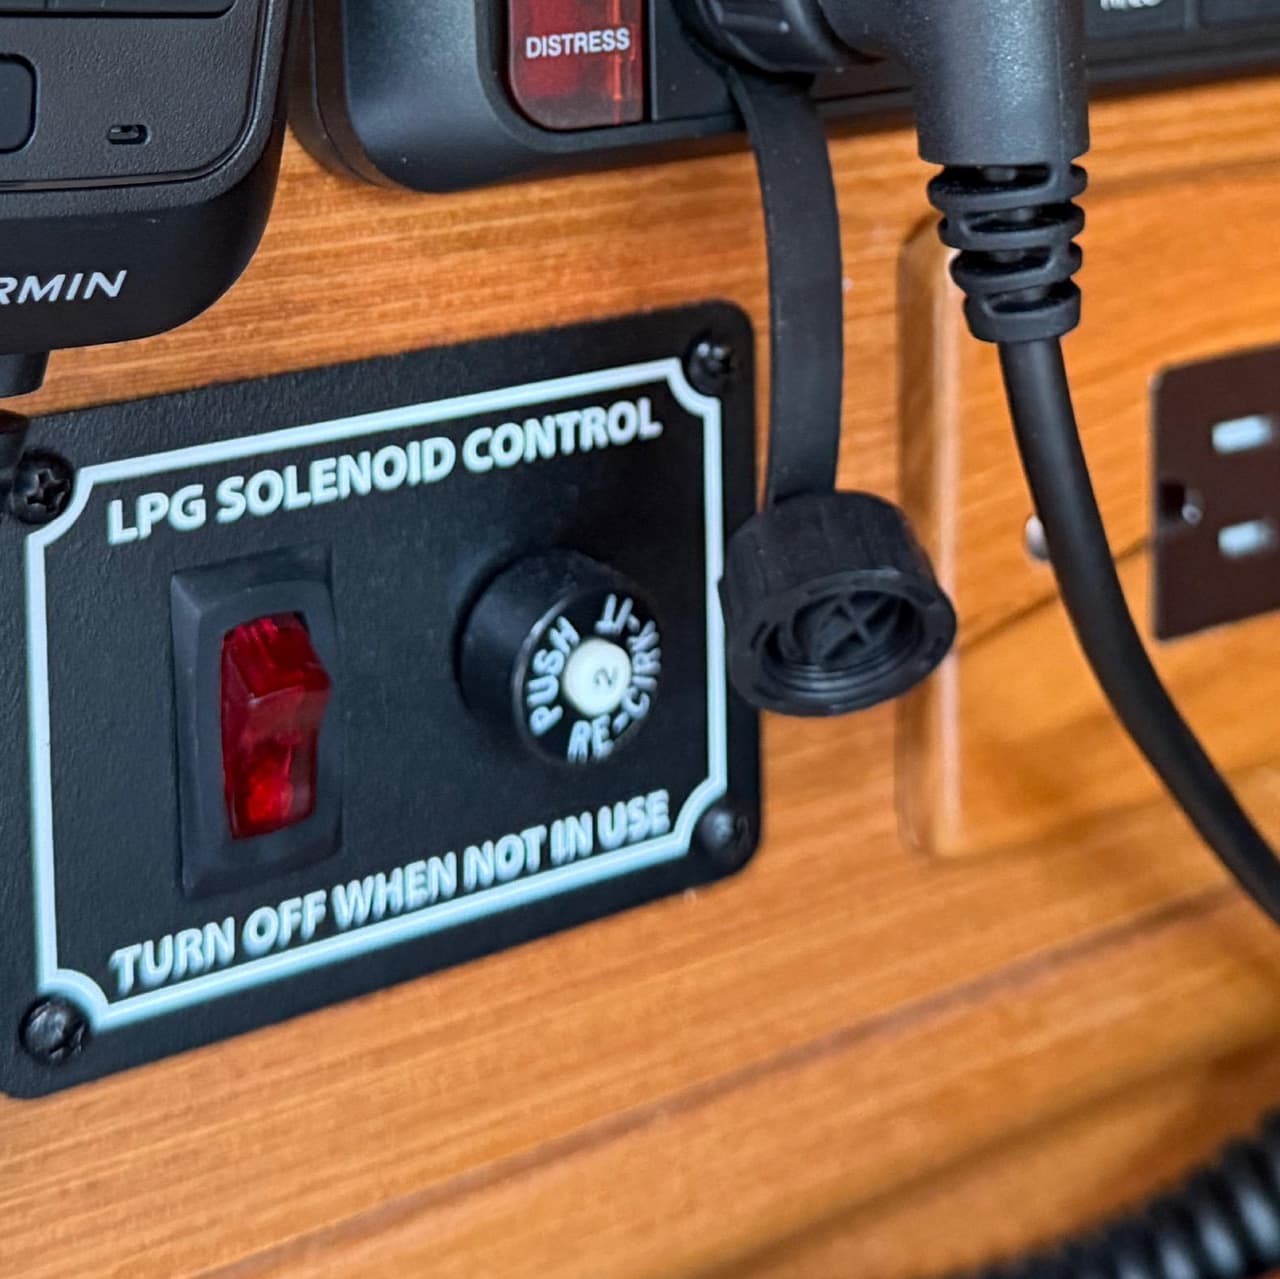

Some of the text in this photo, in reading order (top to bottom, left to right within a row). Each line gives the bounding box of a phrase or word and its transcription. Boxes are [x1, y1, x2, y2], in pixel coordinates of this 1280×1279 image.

[526, 27, 631, 59] DISTRESS
[106, 397, 664, 545] LPG SOLENOID CONTROL
[526, 616, 581, 736] PUSH
[108, 788, 670, 996] TURN OFF WHEN NOT IN USE
